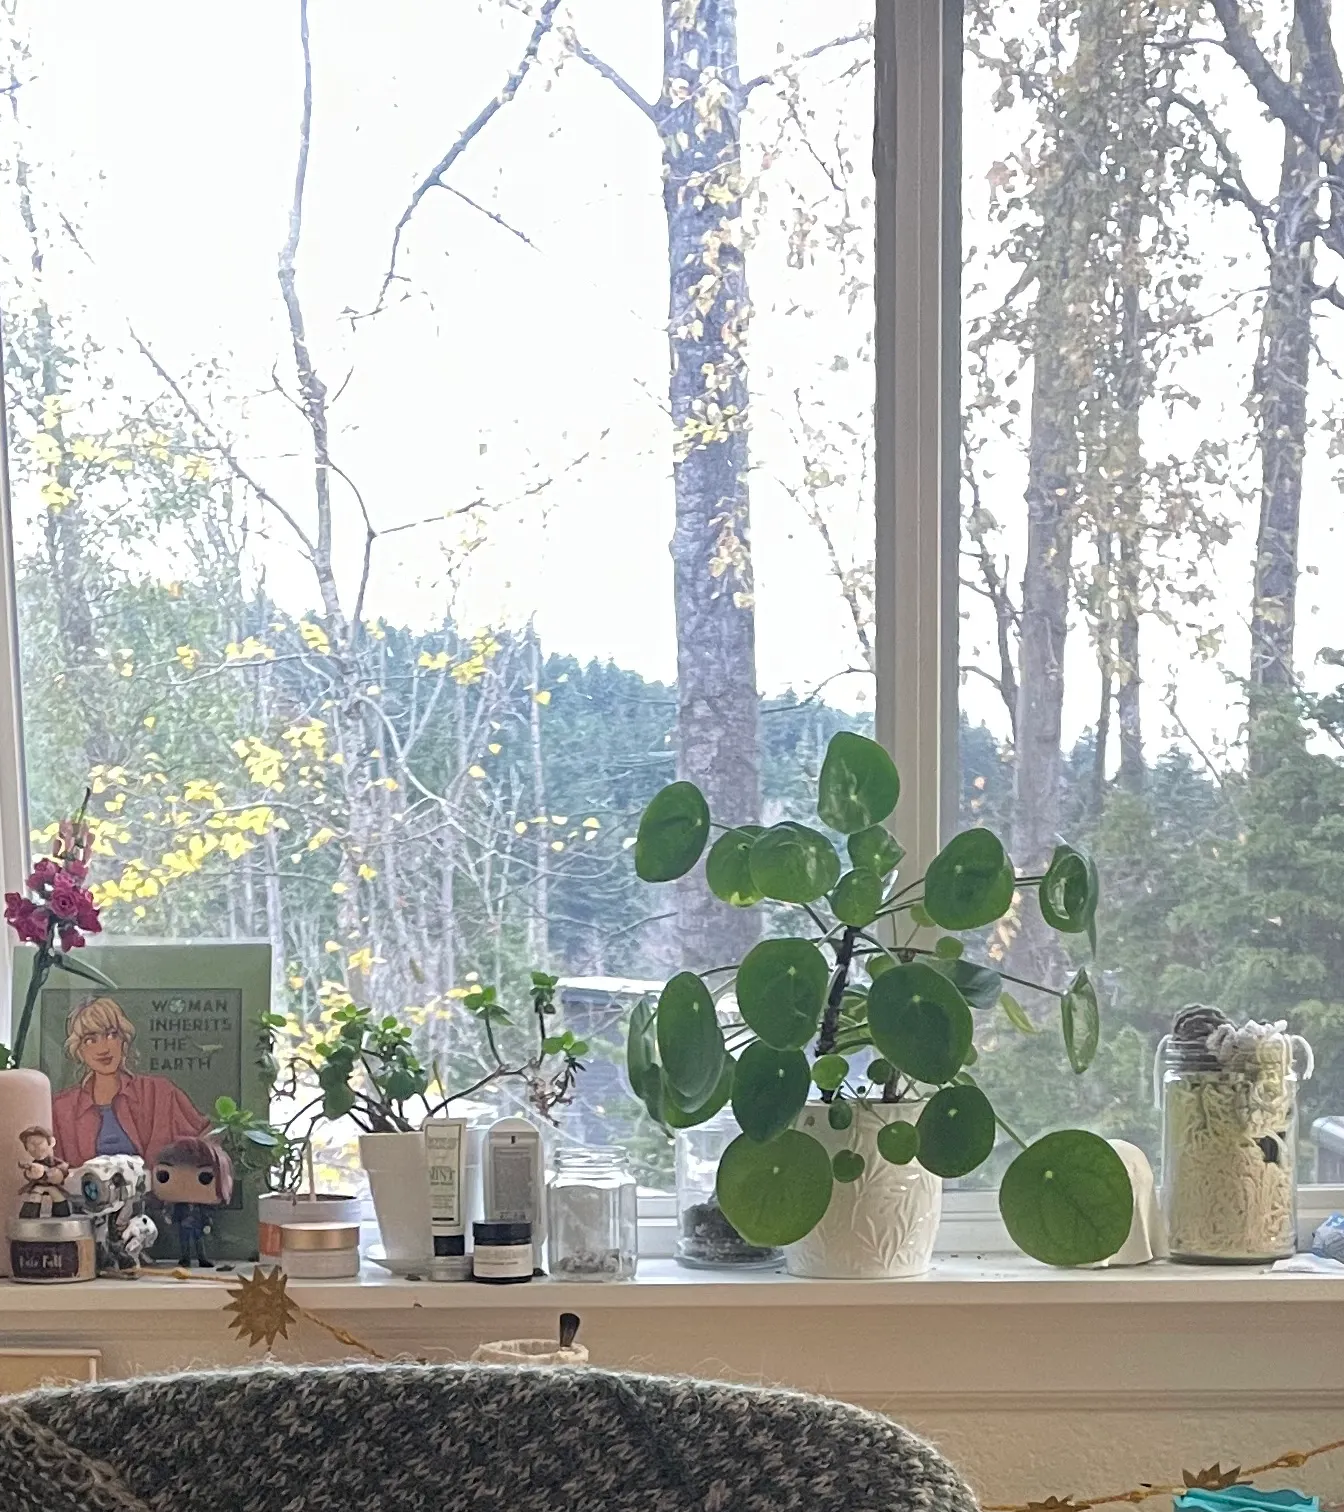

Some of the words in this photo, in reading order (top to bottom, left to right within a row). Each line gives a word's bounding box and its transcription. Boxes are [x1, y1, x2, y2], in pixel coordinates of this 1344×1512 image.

[149, 1018, 233, 1032] INHERITS
[149, 1037, 188, 1051] THE
[149, 1056, 212, 1071] EARTH
